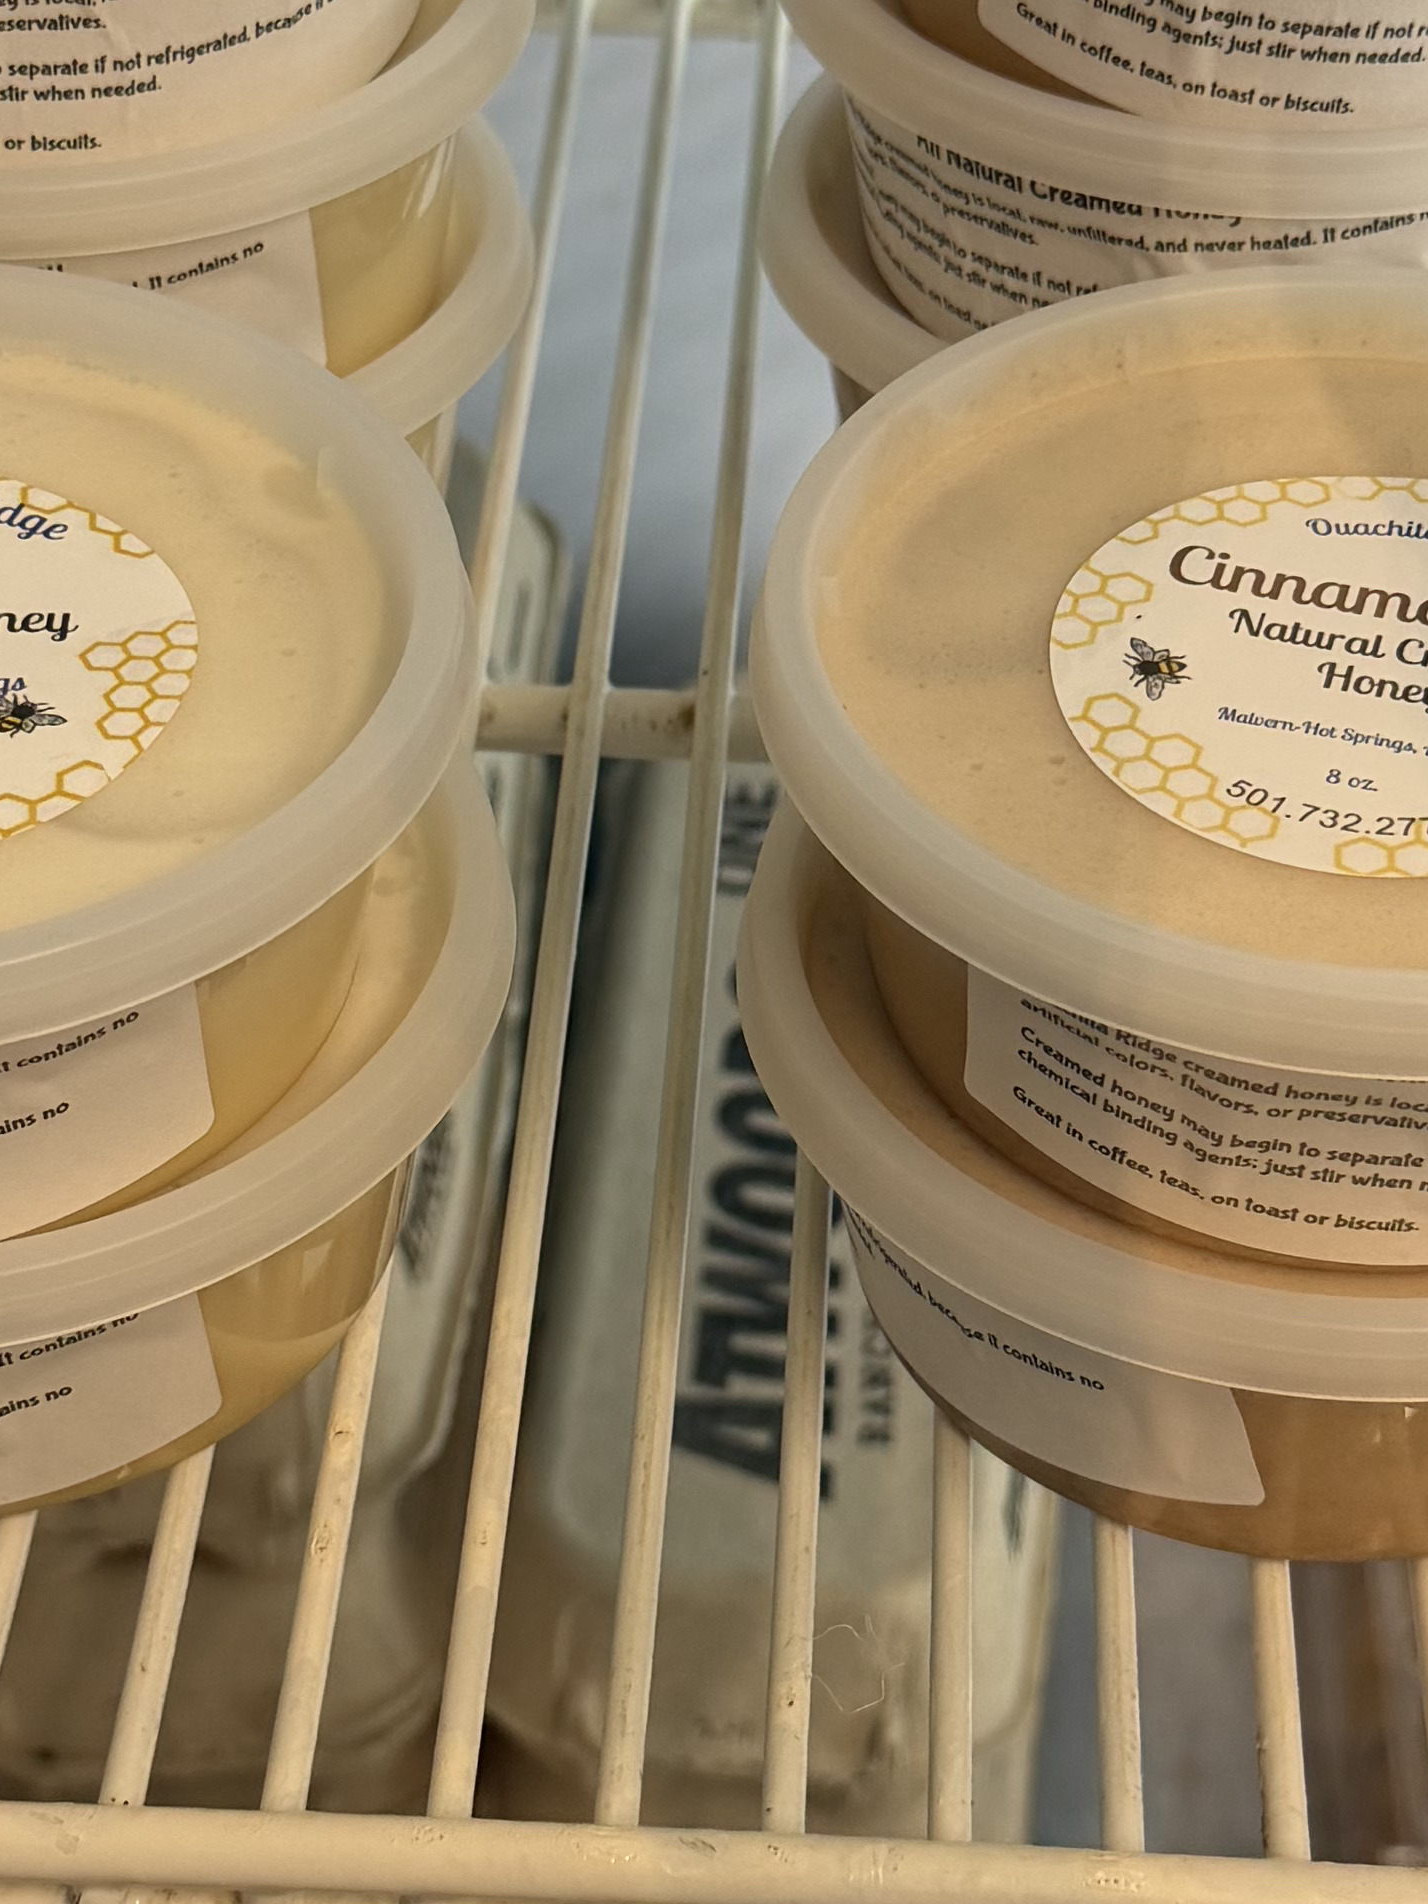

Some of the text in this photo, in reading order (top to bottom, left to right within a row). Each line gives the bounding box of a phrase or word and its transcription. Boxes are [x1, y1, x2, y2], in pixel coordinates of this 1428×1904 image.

[1202, 8, 1254, 30] begin
[1258, 15, 1277, 30] to
[1282, 17, 1361, 42] separate
[1364, 18, 1380, 38] if
[1383, 16, 1413, 38] not
[4, 136, 25, 151] or
[30, 134, 102, 152] biscuits.
[1155, 211, 1414, 254] and never heated. It contains
[167, 241, 264, 284] contains no
[1229, 607, 1385, 659] Natural
[1218, 705, 1337, 740] Malvern-Hot
[1341, 726, 1417, 755] Springs,
[1325, 768, 1378, 792] 8 oz.
[15, 1026, 107, 1070] contains
[111, 1011, 140, 1029] no
[43, 1101, 71, 1118] no
[1017, 1049, 1097, 1105] chemical
[1101, 1098, 1178, 1146] binding
[1183, 1140, 1257, 1174] agents;
[1260, 1157, 1306, 1182] just
[1311, 1165, 1346, 1184] stir
[1350, 1174, 1413, 1191] when
[19, 1322, 108, 1361] contains
[988, 1332, 1105, 1391] it contains no
[46, 1384, 73, 1400] no
